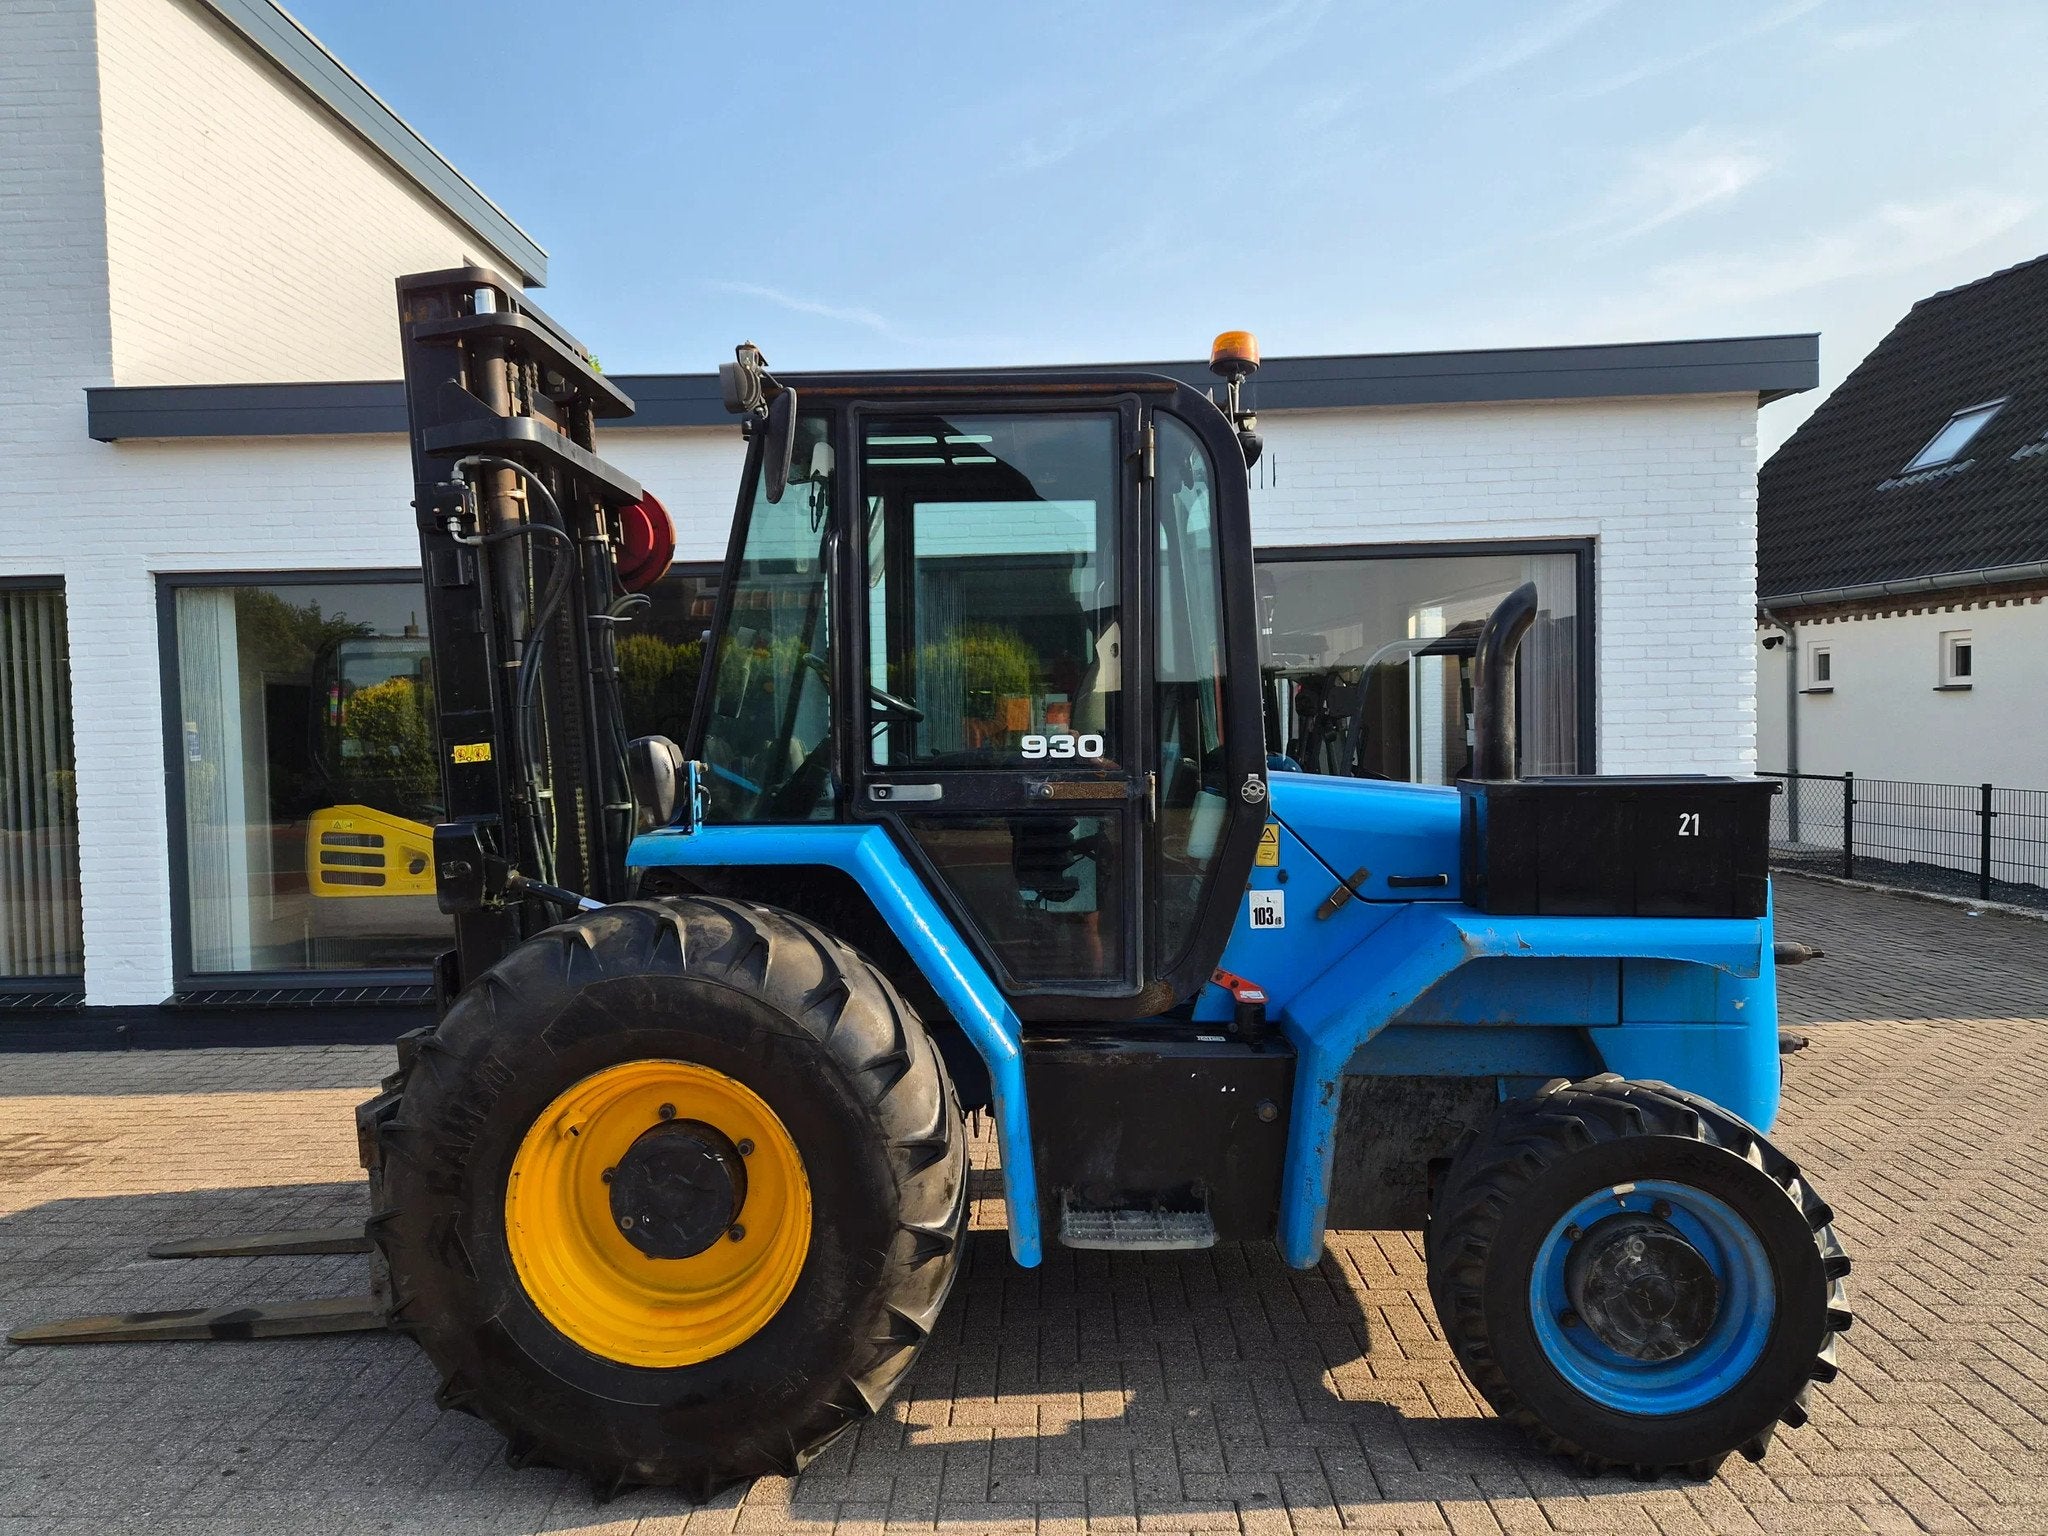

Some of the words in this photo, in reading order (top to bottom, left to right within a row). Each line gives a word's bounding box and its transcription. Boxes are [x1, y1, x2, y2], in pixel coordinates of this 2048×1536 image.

[1021, 734, 1104, 759] 930
[1678, 812, 1700, 836] 21
[1253, 907, 1274, 925] 103
